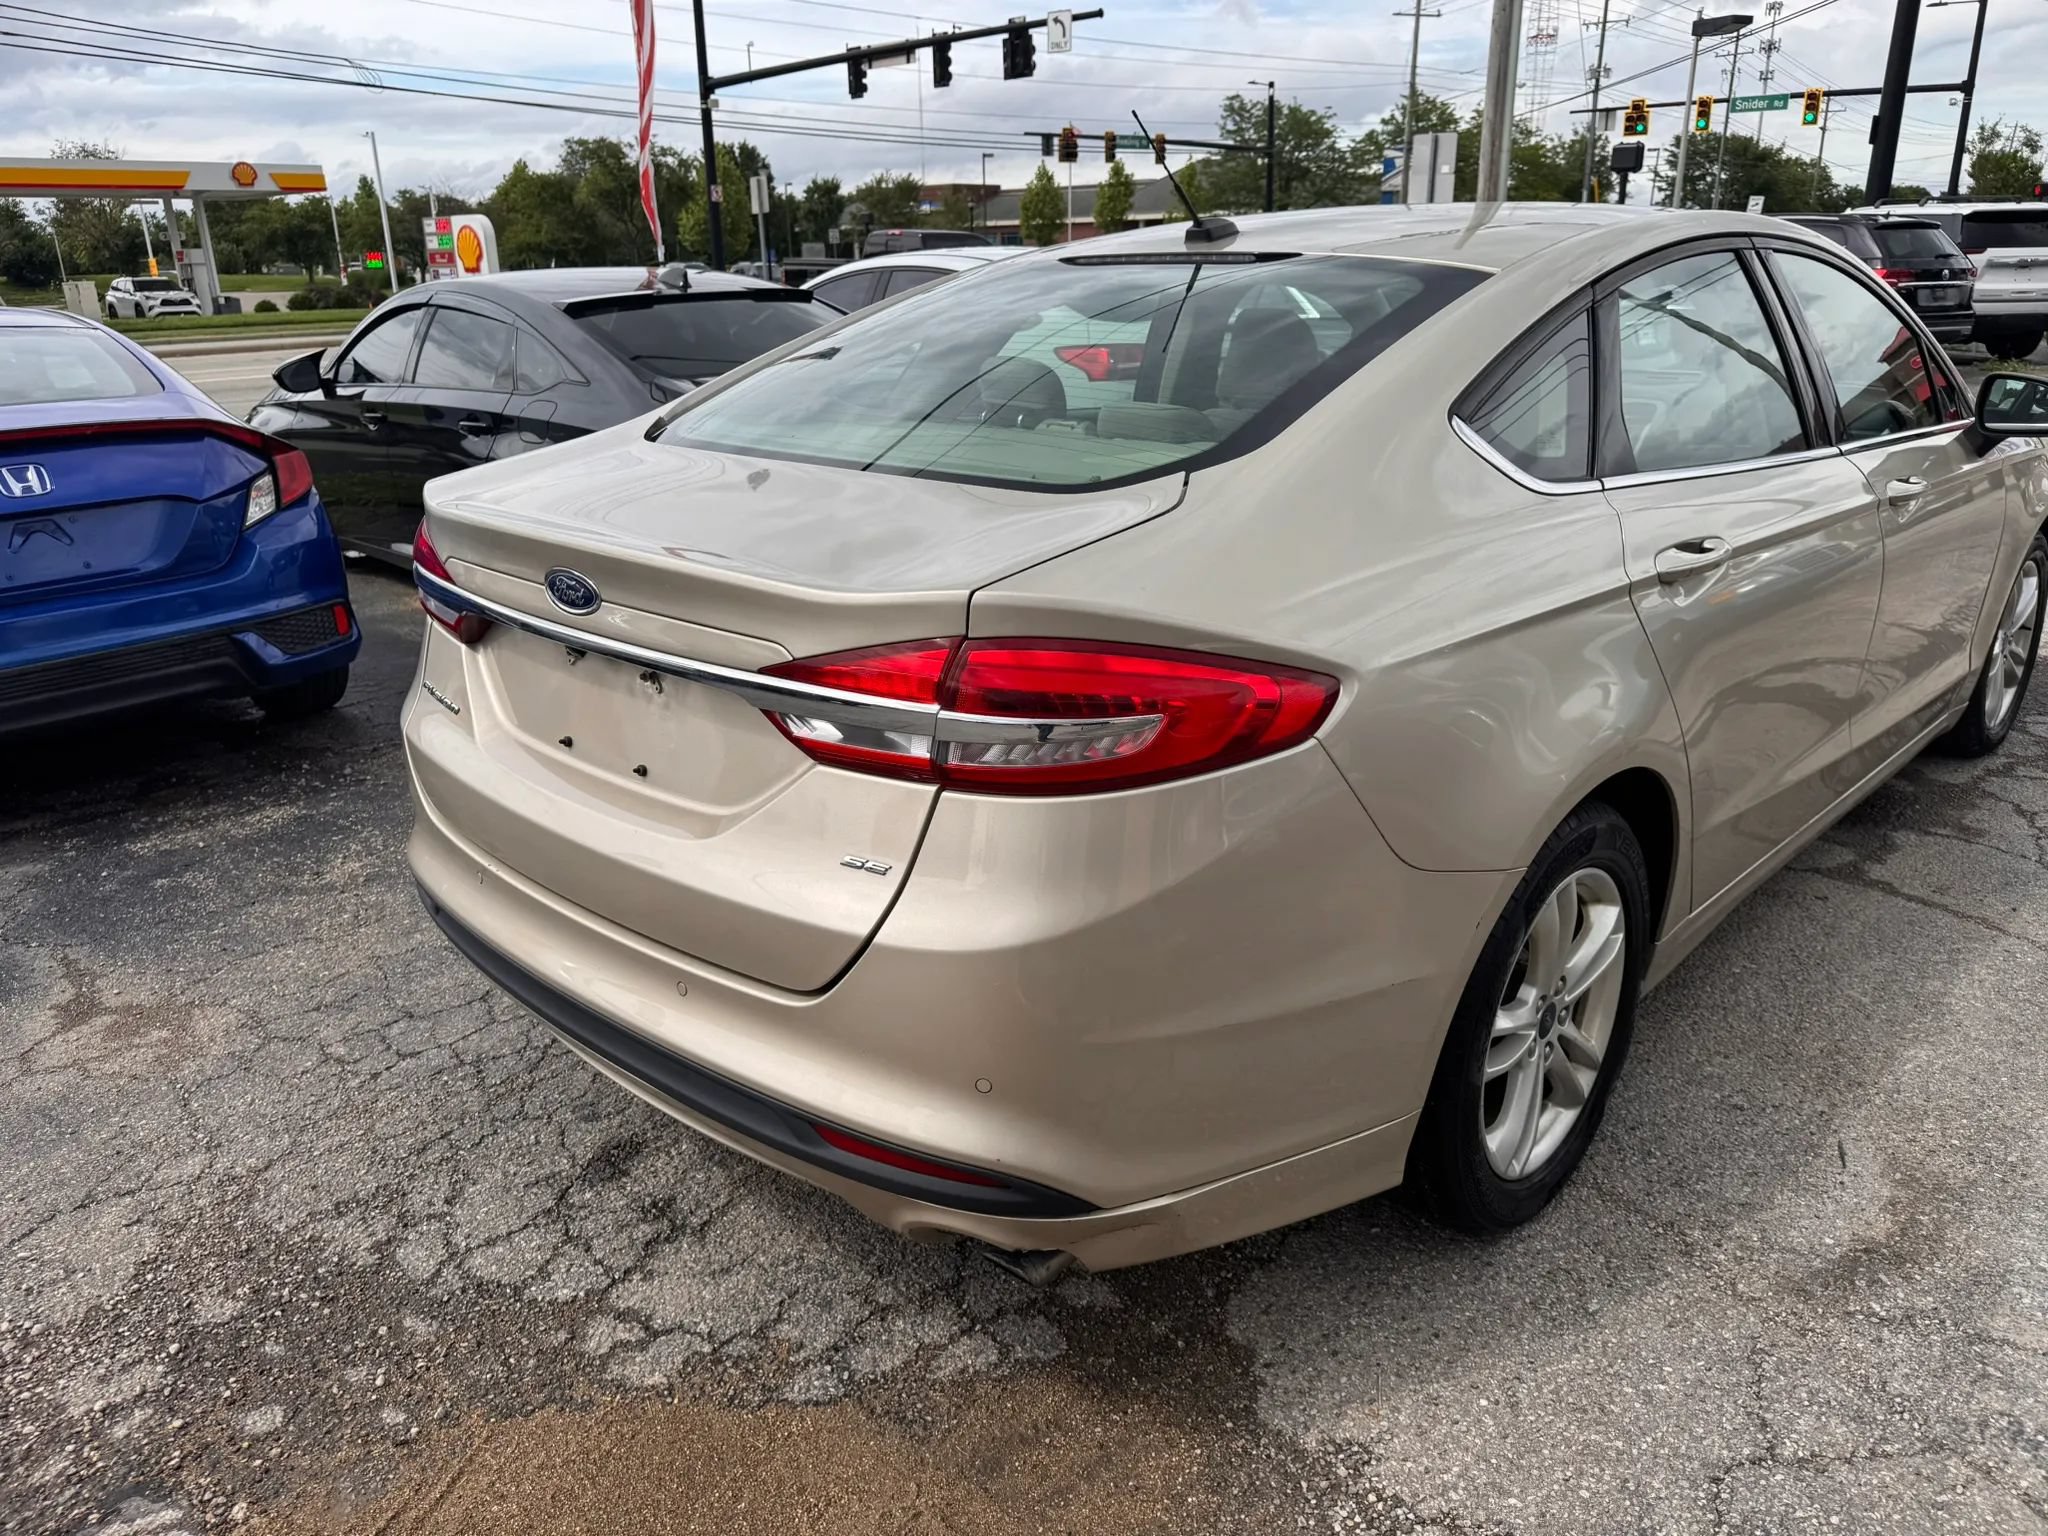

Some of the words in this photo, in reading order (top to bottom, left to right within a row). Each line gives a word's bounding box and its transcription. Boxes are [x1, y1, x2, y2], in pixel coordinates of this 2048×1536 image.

[1050, 41, 1069, 50] ONLY
[1735, 99, 1769, 111] Snider
[1773, 100, 1785, 108] Rd
[553, 575, 586, 606] Ford
[839, 855, 893, 876] SE
